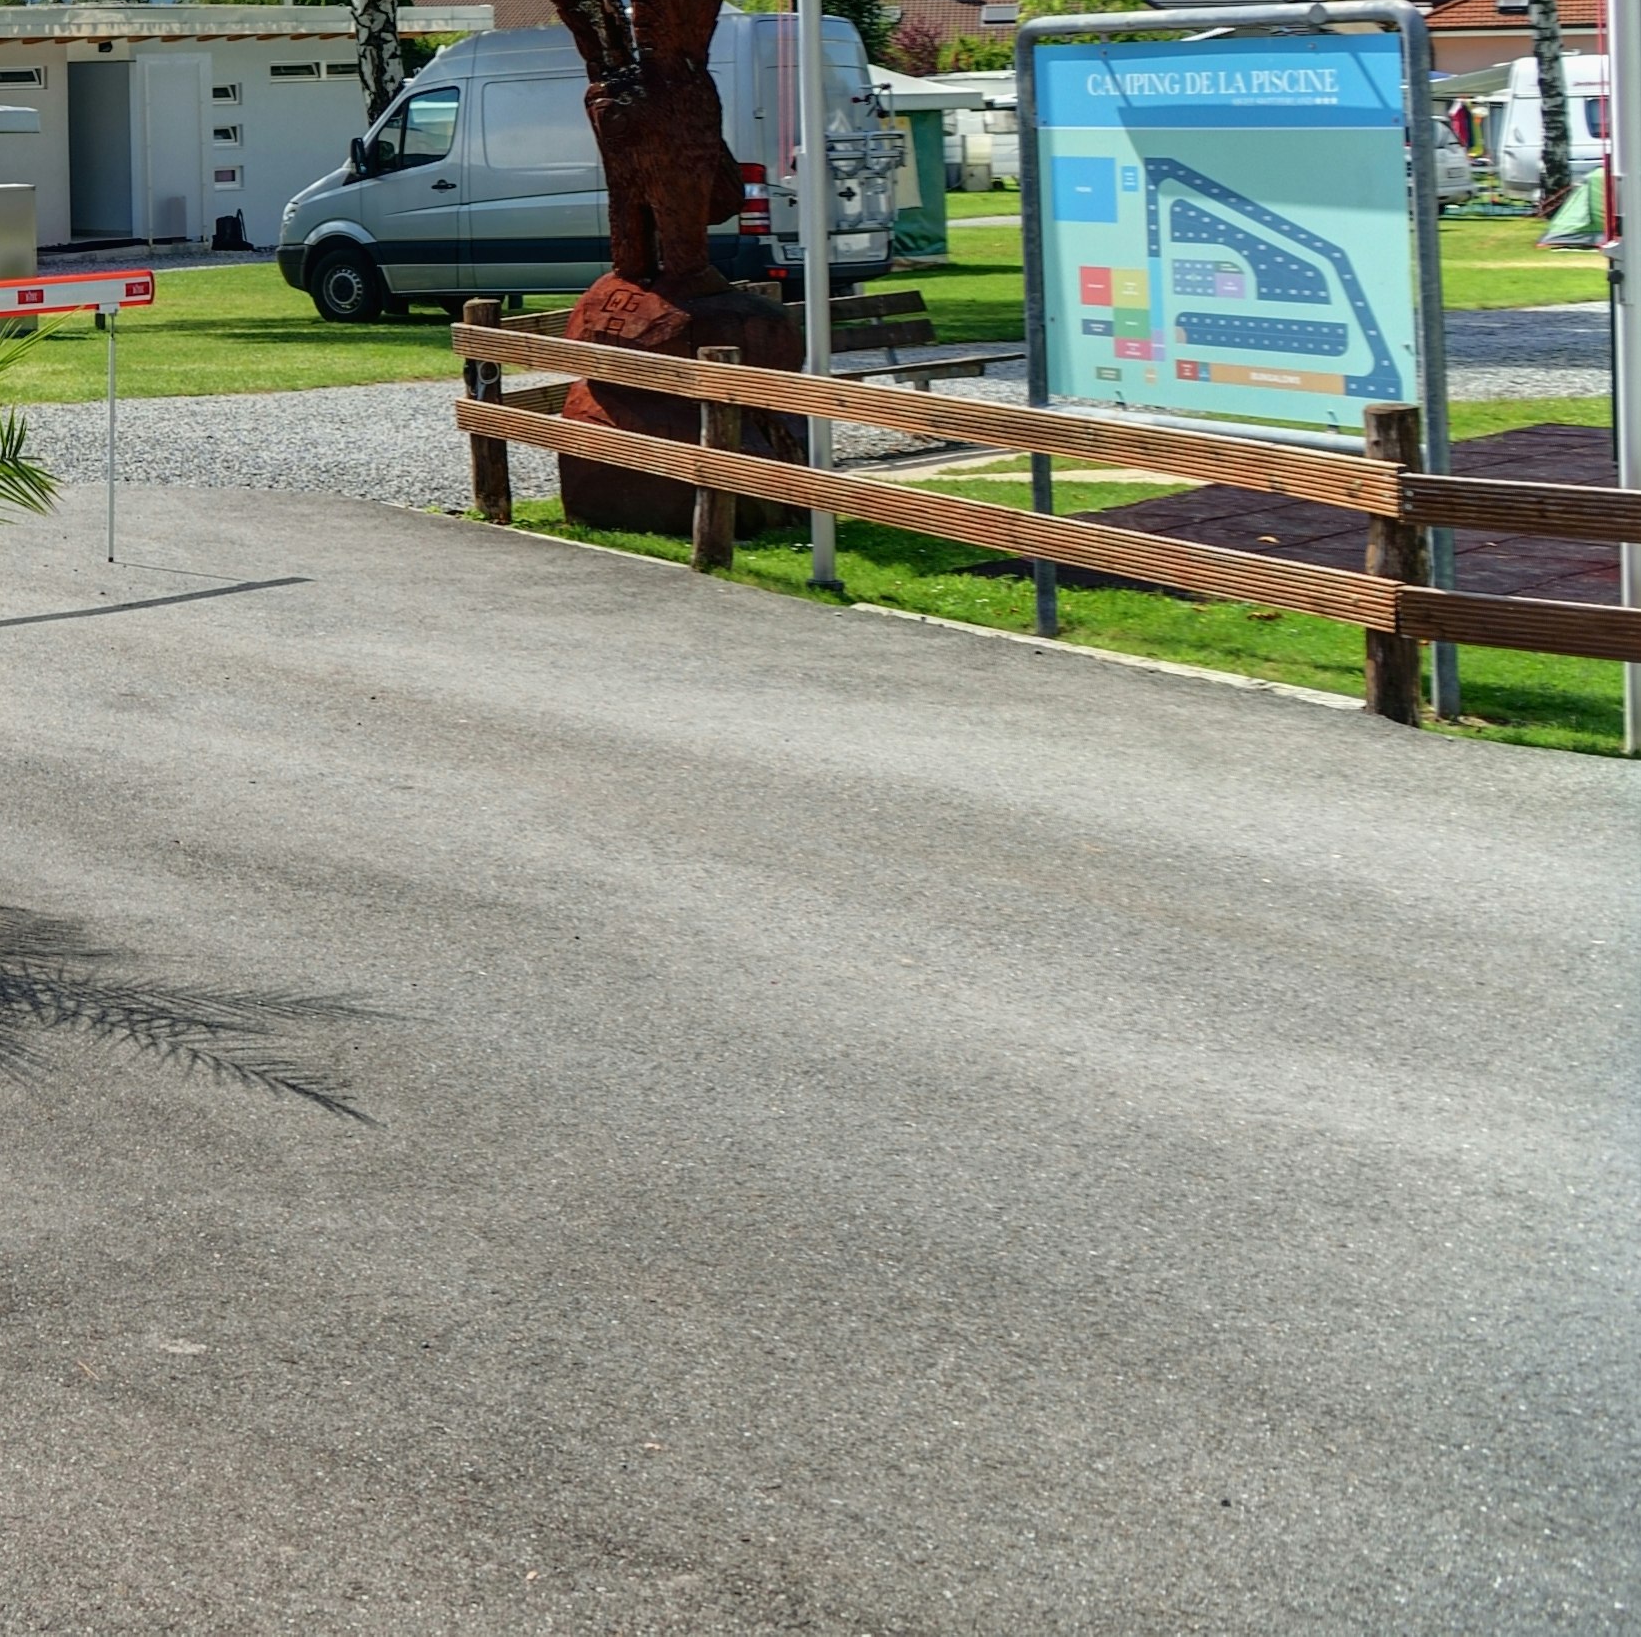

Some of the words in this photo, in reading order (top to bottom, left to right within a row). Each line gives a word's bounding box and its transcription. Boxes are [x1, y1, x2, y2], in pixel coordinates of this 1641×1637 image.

[1086, 72, 1181, 96] CAMPING
[1184, 71, 1214, 95] DE
[1219, 71, 1246, 94] LA
[1251, 69, 1338, 93] PISCINE
